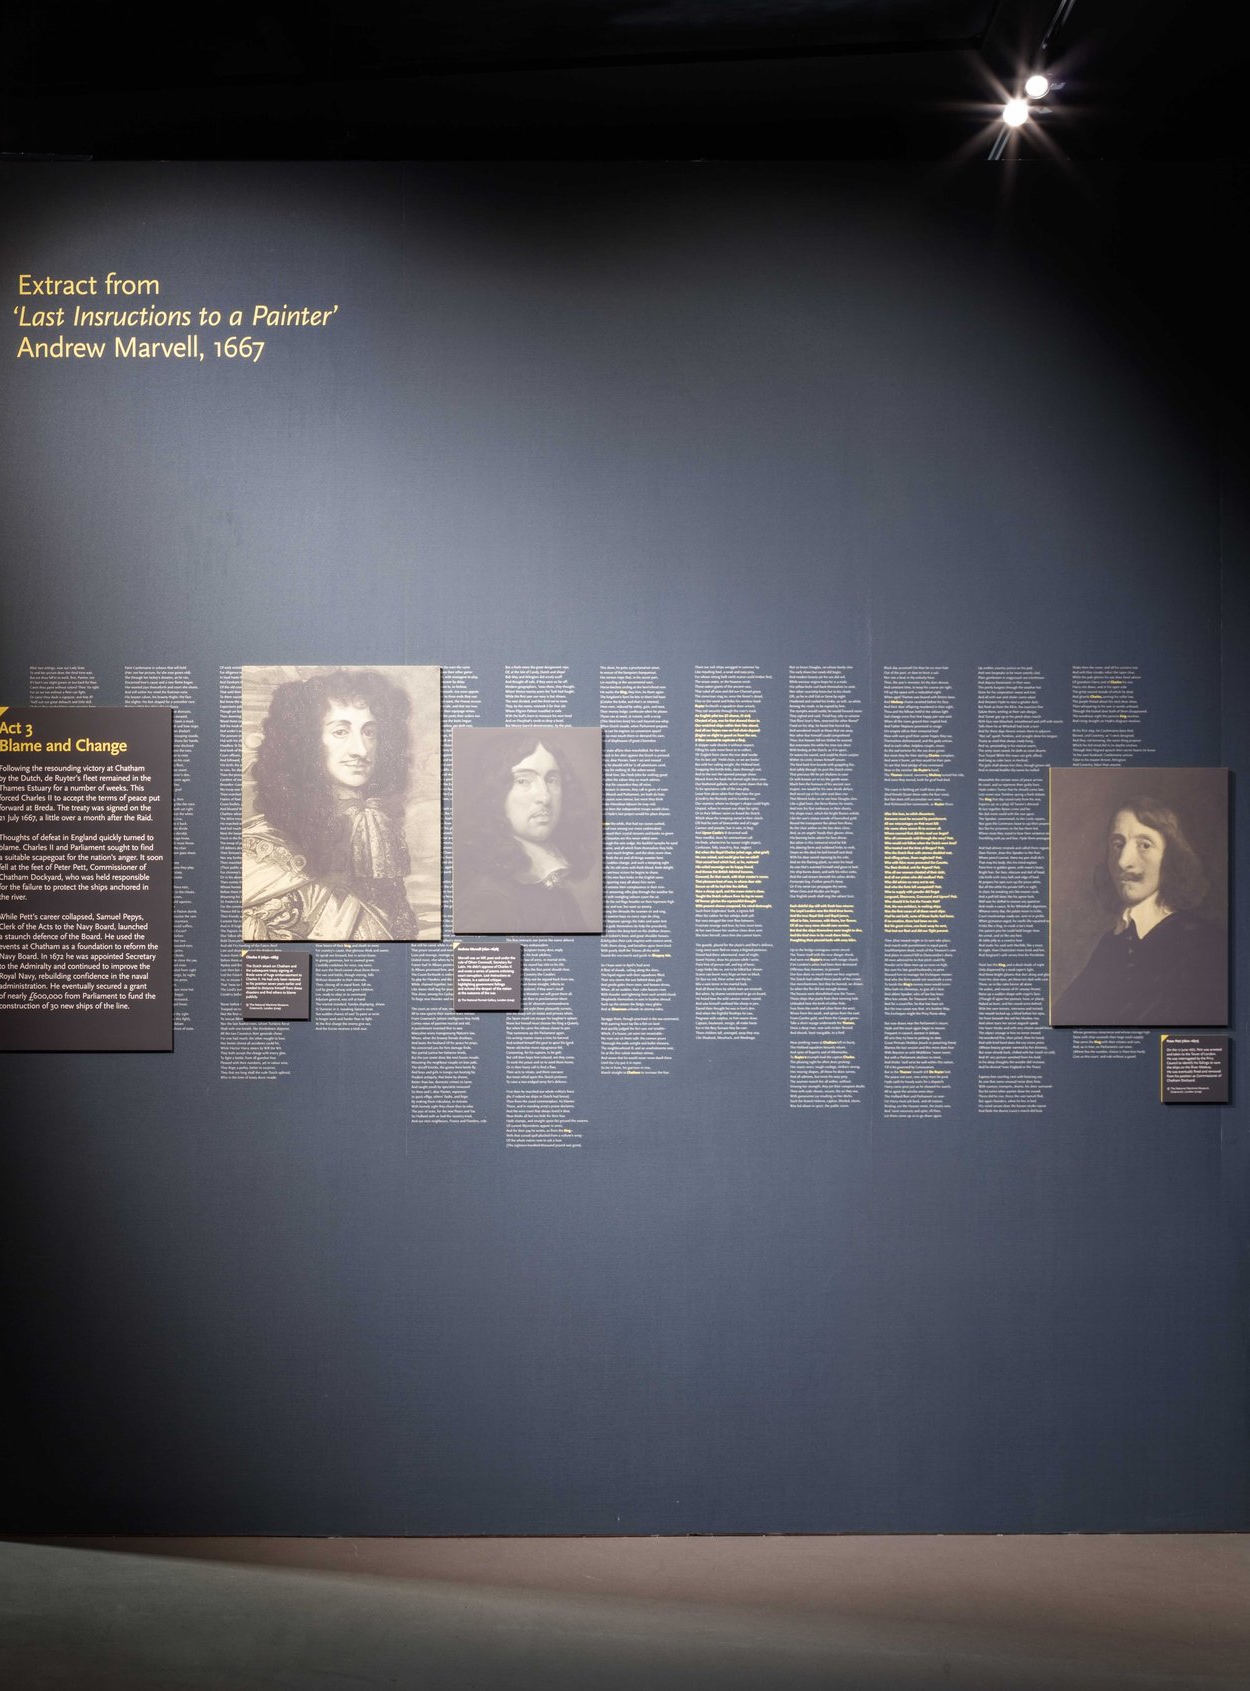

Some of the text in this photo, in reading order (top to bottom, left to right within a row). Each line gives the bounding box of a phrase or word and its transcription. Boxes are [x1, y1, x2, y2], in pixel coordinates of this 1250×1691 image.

[19, 272, 159, 295] Extract from
[14, 304, 338, 327] ‘Last Insructions to a Painter’
[16, 334, 265, 363] Andrew Marvell, 1667
[26, 724, 33, 738] 3
[0, 737, 128, 756] Blame and Change
[44, 764, 82, 774] resounding
[82, 765, 106, 773] victory
[20, 774, 43, 782] Dutch,
[54, 774, 81, 783] Ruyter's
[140, 774, 152, 782] the
[27, 784, 52, 793] Estuary
[71, 805, 90, 813] treaty
[106, 804, 128, 813] signed
[7, 814, 20, 823] July
[21, 814, 38, 822] 1667,
[107, 812, 123, 821] after
[70, 834, 98, 843] England
[98, 834, 122, 842] quickly
[107, 844, 130, 853] sought
[32, 854, 66, 862] scapegoat
[30, 863, 44, 871] feet
[30, 873, 64, 882] Dockyard,
[112, 873, 150, 882] responsible
[90, 883, 108, 892] ships
